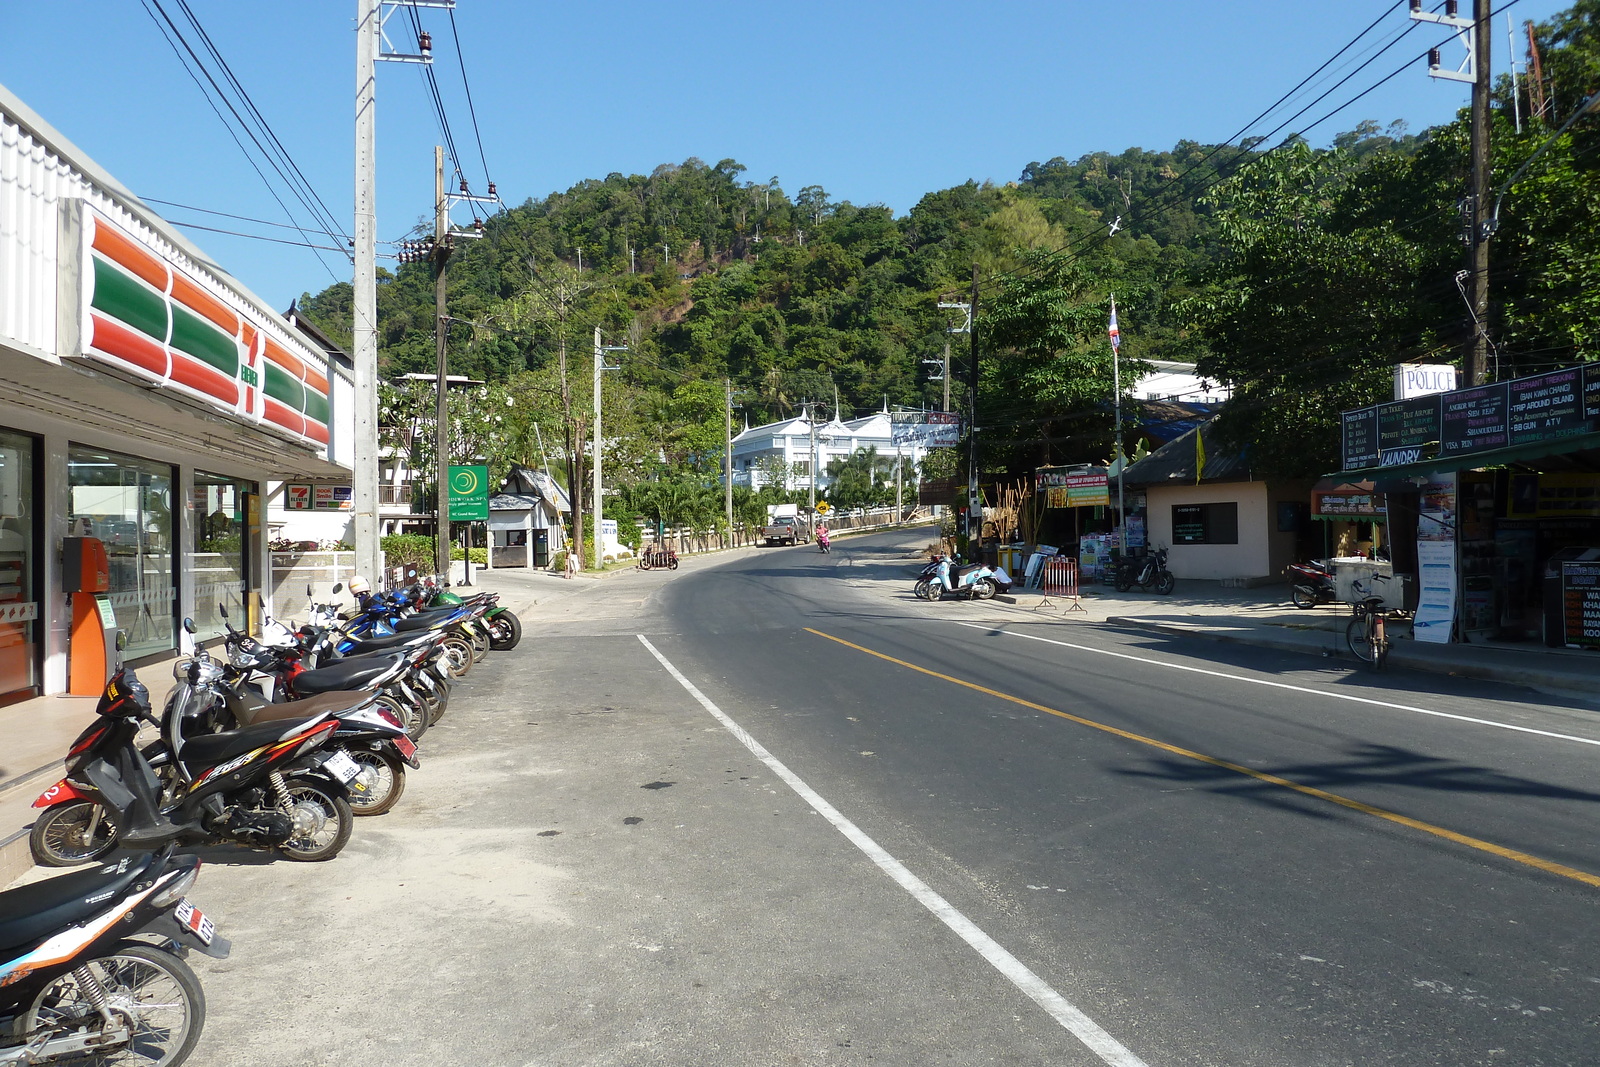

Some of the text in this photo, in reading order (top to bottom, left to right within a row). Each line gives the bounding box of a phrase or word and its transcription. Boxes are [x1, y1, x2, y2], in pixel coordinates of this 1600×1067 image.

[1407, 370, 1454, 390] POLICE
[1545, 372, 1576, 385] TREKKING
[1549, 383, 1571, 395] CHANG)
[1585, 382, 1600, 392] JUN
[1512, 403, 1526, 413] TRIP
[1527, 398, 1551, 410] AROUND
[1552, 394, 1575, 405] ISLAND
[1415, 408, 1434, 418] AIRPORT
[1523, 421, 1537, 430] GUN
[1381, 449, 1421, 467] LAUNDRY
[1564, 566, 1587, 576] BANG
[1572, 576, 1597, 585] BOAT
[1583, 601, 1600, 609] KHA
[241, 638, 255, 650] 34
[200, 917, 214, 942] 474
